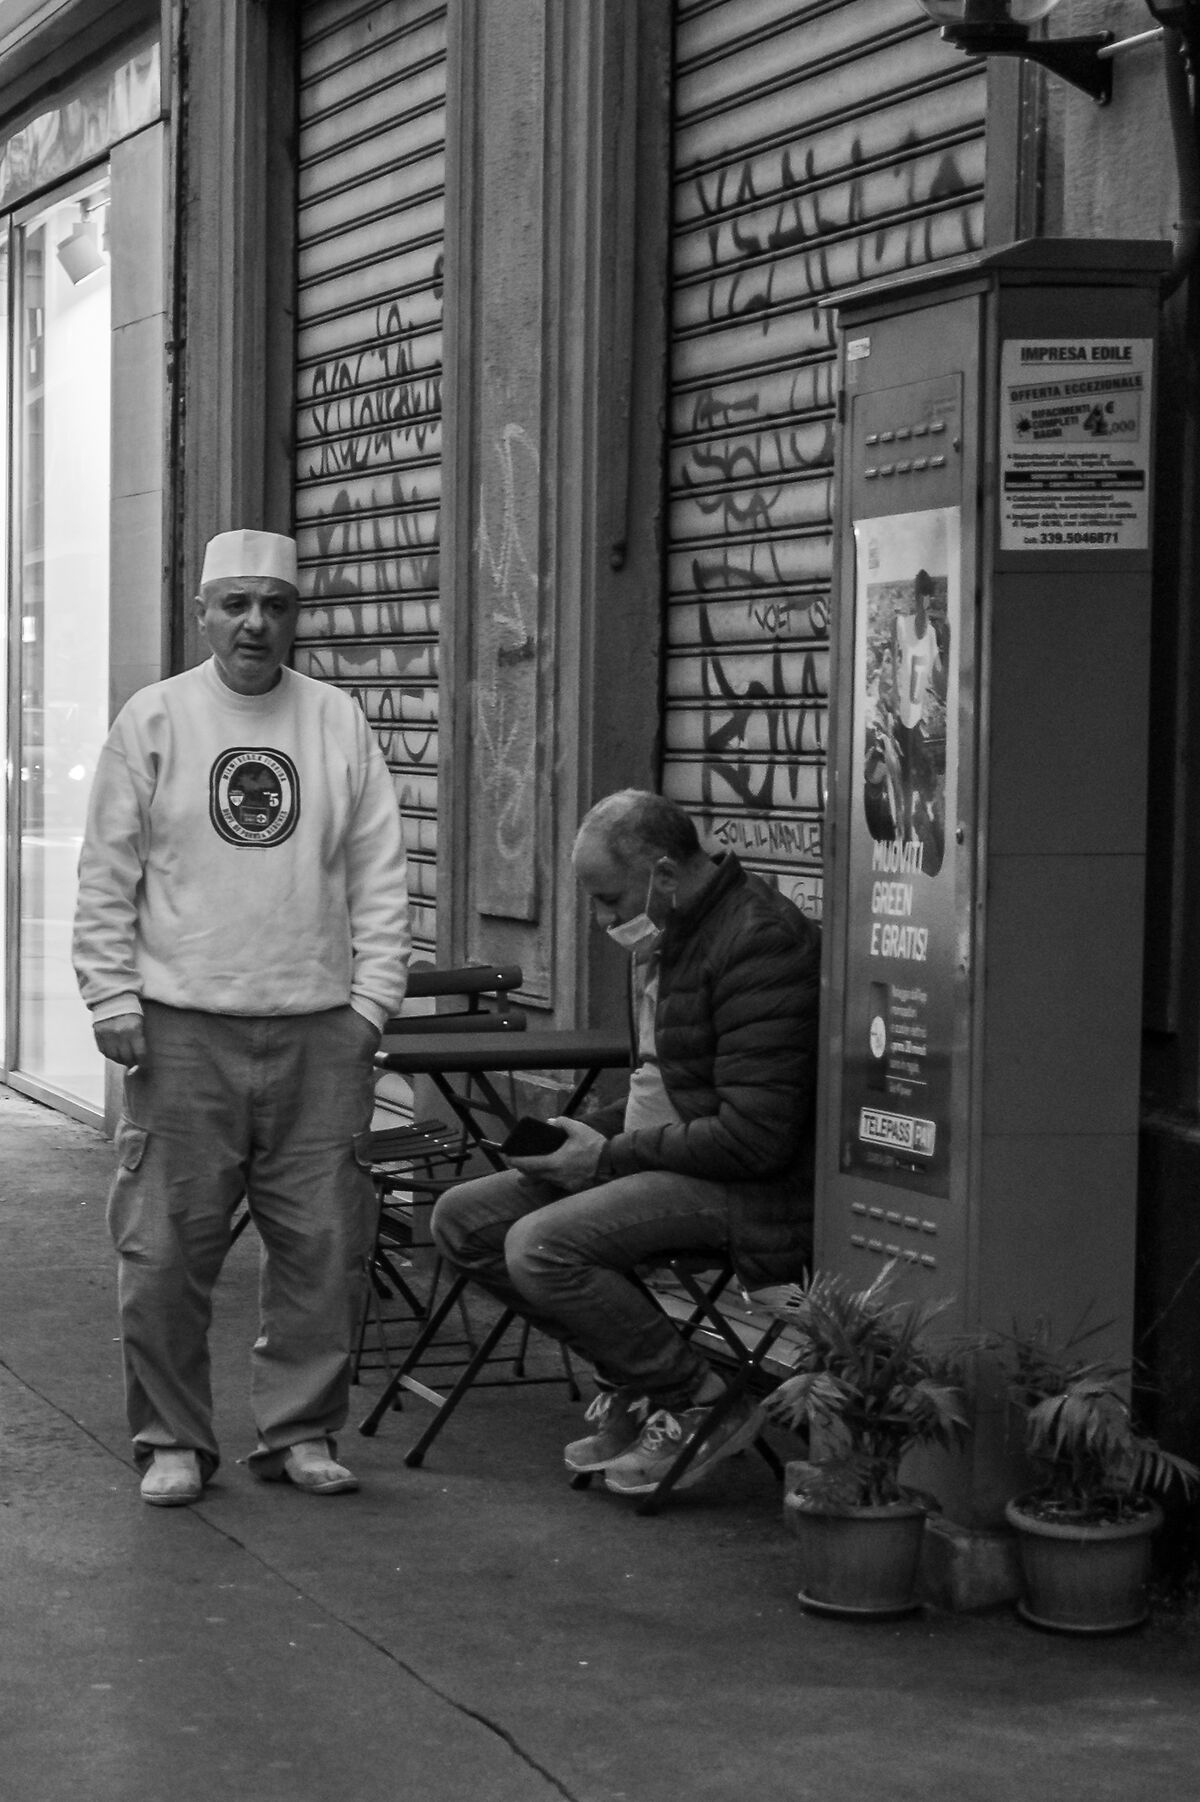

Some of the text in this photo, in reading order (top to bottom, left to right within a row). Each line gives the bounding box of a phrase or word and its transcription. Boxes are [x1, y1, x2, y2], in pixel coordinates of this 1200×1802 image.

[1020, 345, 1133, 362] IMPRESA EDILE
[1010, 374, 1143, 402] OFFERTA ECCEZIONALE
[269, 792, 280, 808] 5
[872, 839, 924, 874] MUOVITI
[871, 881, 913, 917] GREEN
[870, 922, 882, 956] E
[863, 1114, 911, 1143] TELEPASS
